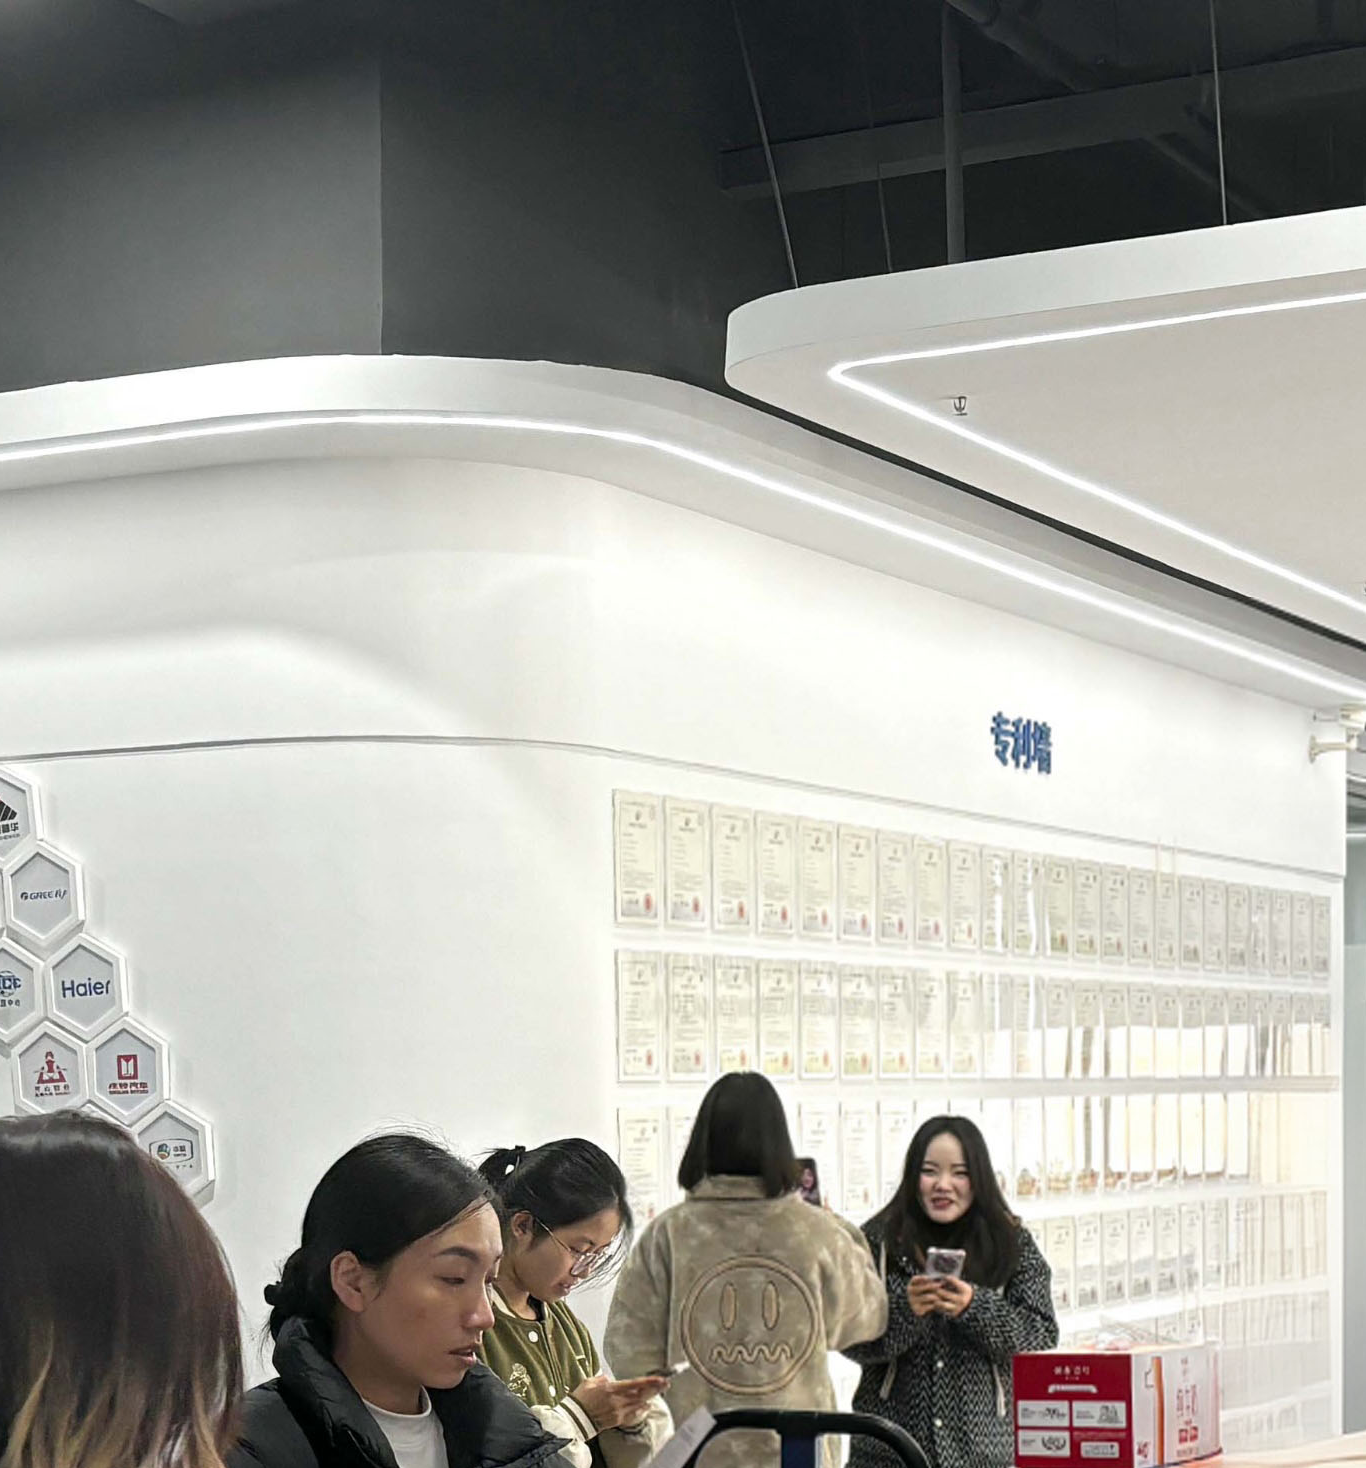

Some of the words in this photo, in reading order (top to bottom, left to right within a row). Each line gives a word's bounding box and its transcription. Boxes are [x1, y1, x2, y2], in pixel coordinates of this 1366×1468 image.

[990, 710, 1052, 775] 专利墙
[61, 977, 111, 999] Haier
